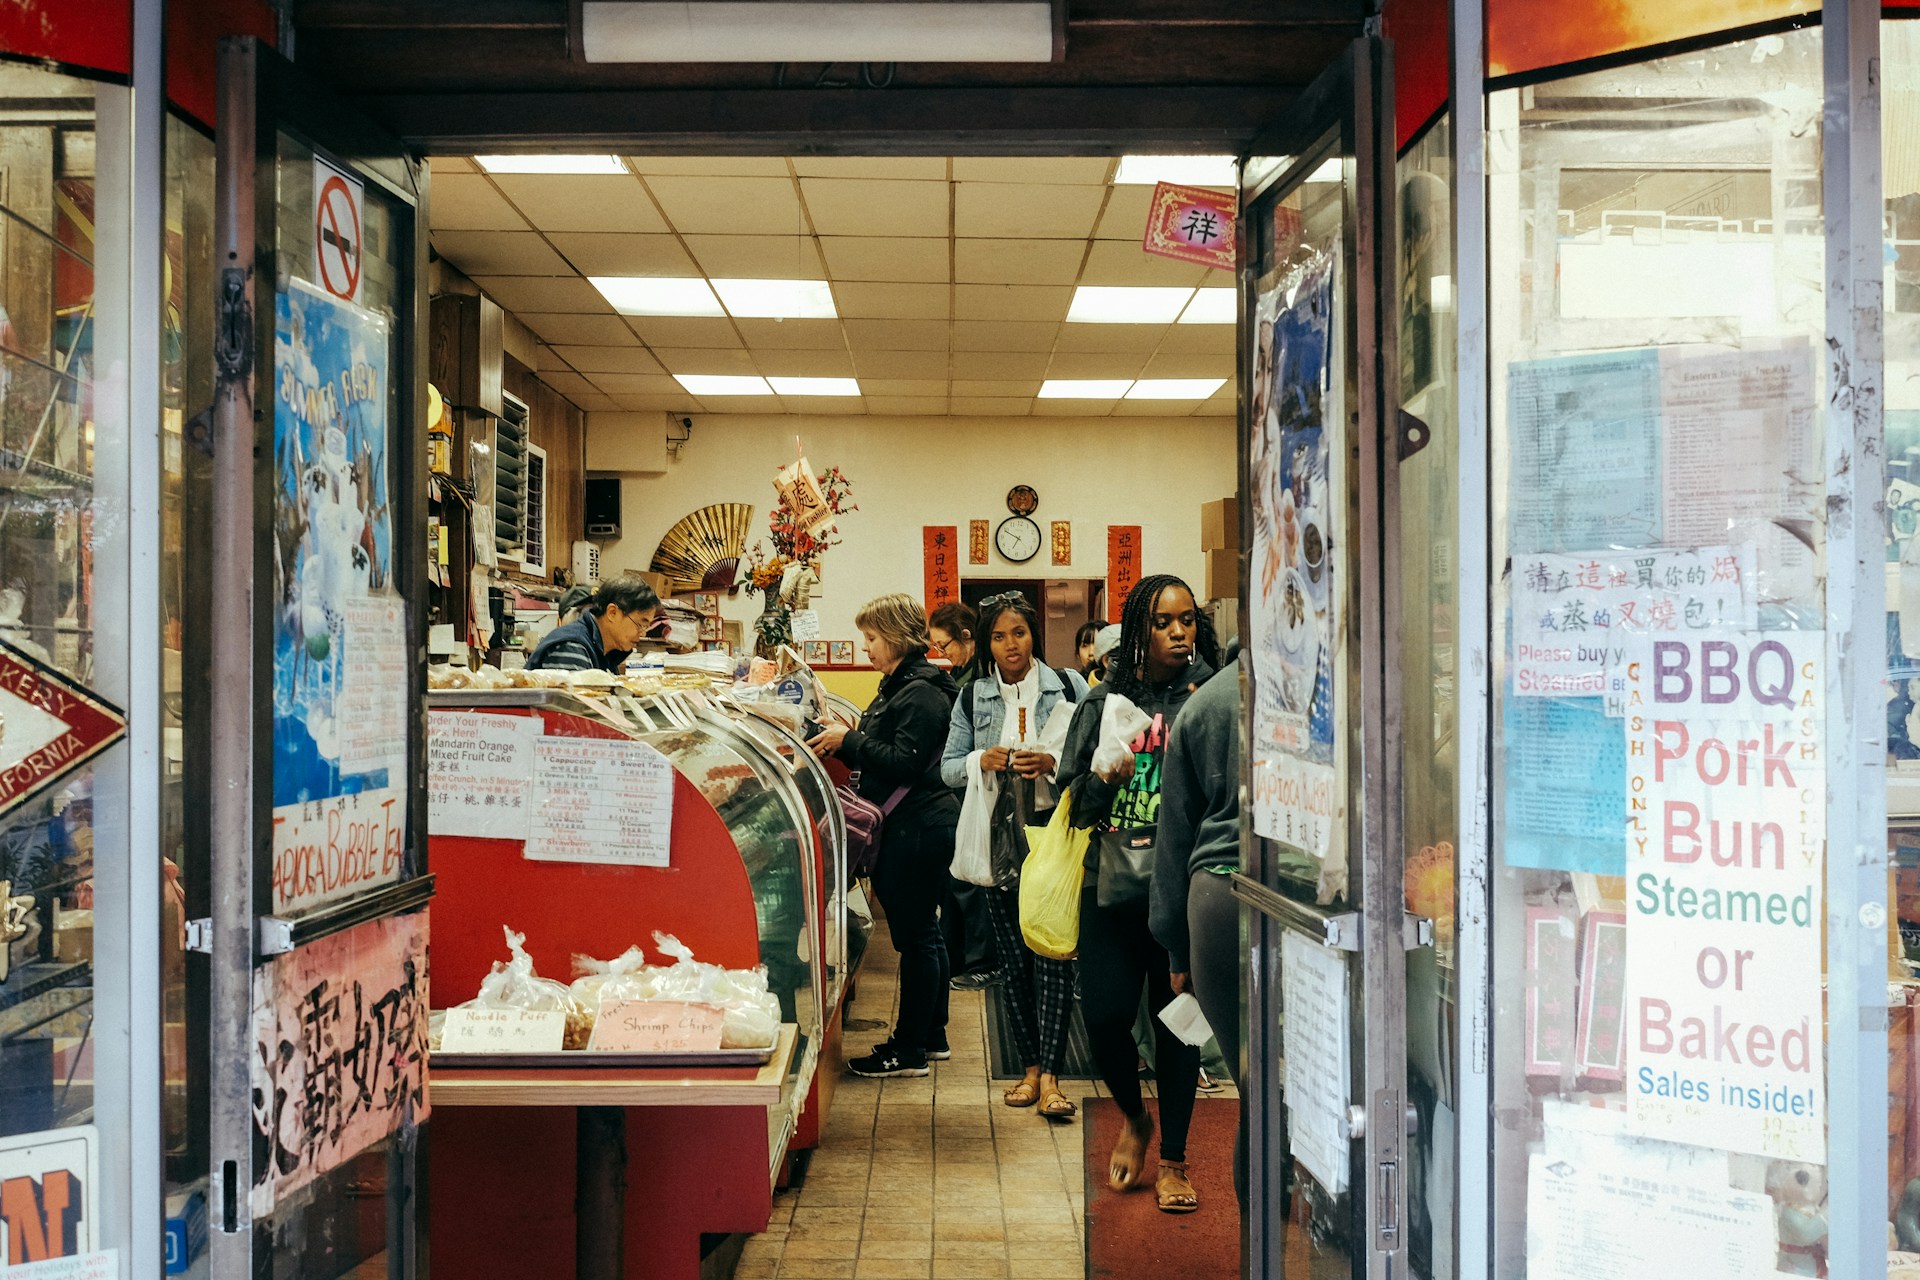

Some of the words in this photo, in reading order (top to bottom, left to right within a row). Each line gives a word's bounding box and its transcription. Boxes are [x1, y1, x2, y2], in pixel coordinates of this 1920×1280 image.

[1181, 209, 1218, 244] 祥
[1518, 644, 1572, 663] Please
[1577, 644, 1611, 667] buy
[0, 663, 76, 716] KERY
[1518, 668, 1606, 691] Steamed
[1653, 640, 1798, 711] BBQ
[456, 716, 478, 727] Your
[482, 717, 517, 731] Freshly
[1627, 661, 1644, 757] CASH
[430, 738, 476, 750] Mandarin
[478, 740, 517, 754] Orange,
[430, 749, 459, 760] Mixed
[461, 750, 485, 762] Fruit
[487, 752, 512, 763] Cake
[550, 756, 597, 765] Cappuccino
[1653, 720, 1798, 788] Pork
[0, 733, 84, 800] IFORNIA
[480, 776, 488, 784] in
[381, 798, 402, 875] TEA
[546, 838, 592, 847] Strawberry
[1663, 800, 1785, 870] Bun
[1635, 872, 1813, 929] Steamed
[1696, 946, 1755, 992] or
[466, 1011, 508, 1022] Noodle
[519, 1010, 549, 1021] Puff
[623, 1017, 670, 1035] Shrimp
[678, 1017, 714, 1035] Chips
[1639, 996, 1811, 1073] Baked
[1638, 1066, 1710, 1102] Sales
[1720, 1077, 1815, 1117] inside!
[86, 1255, 108, 1267] with
